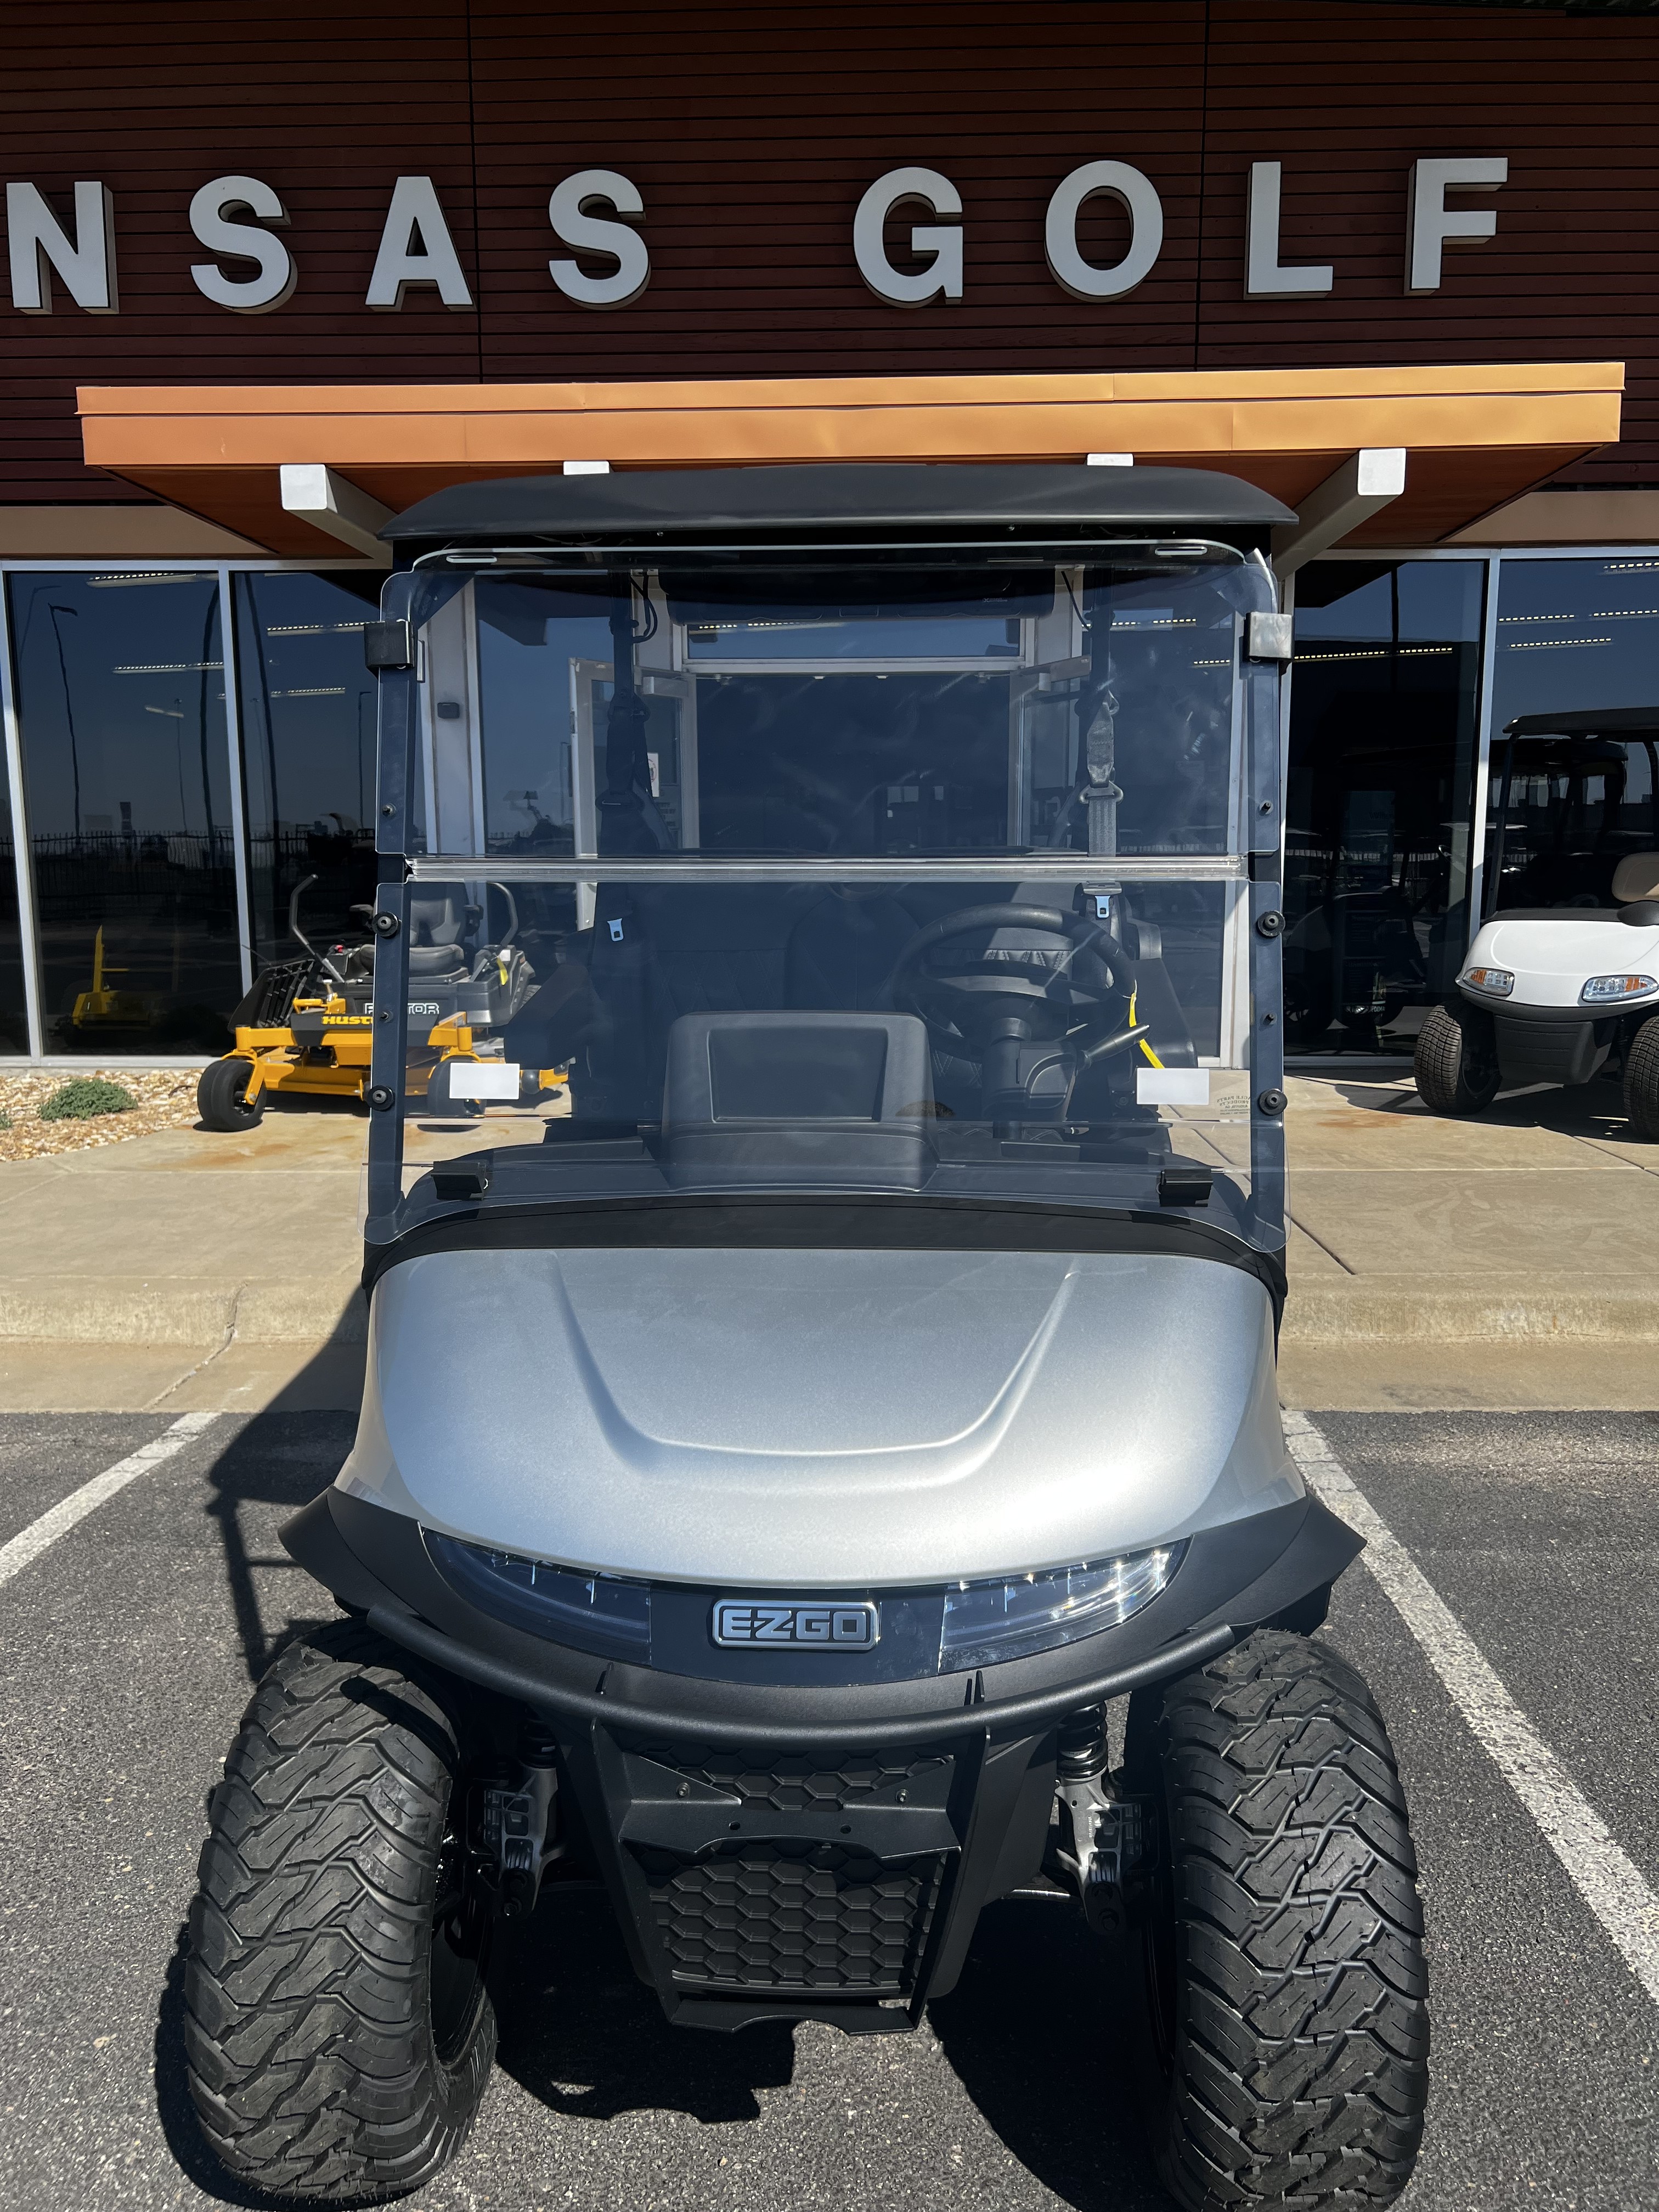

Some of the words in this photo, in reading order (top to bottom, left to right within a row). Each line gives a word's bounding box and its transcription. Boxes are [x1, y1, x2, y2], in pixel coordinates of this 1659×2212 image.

[853, 157, 1509, 305] GOLF
[364, 1002, 439, 1015] RTOR
[722, 1608, 867, 1641] EZGO
